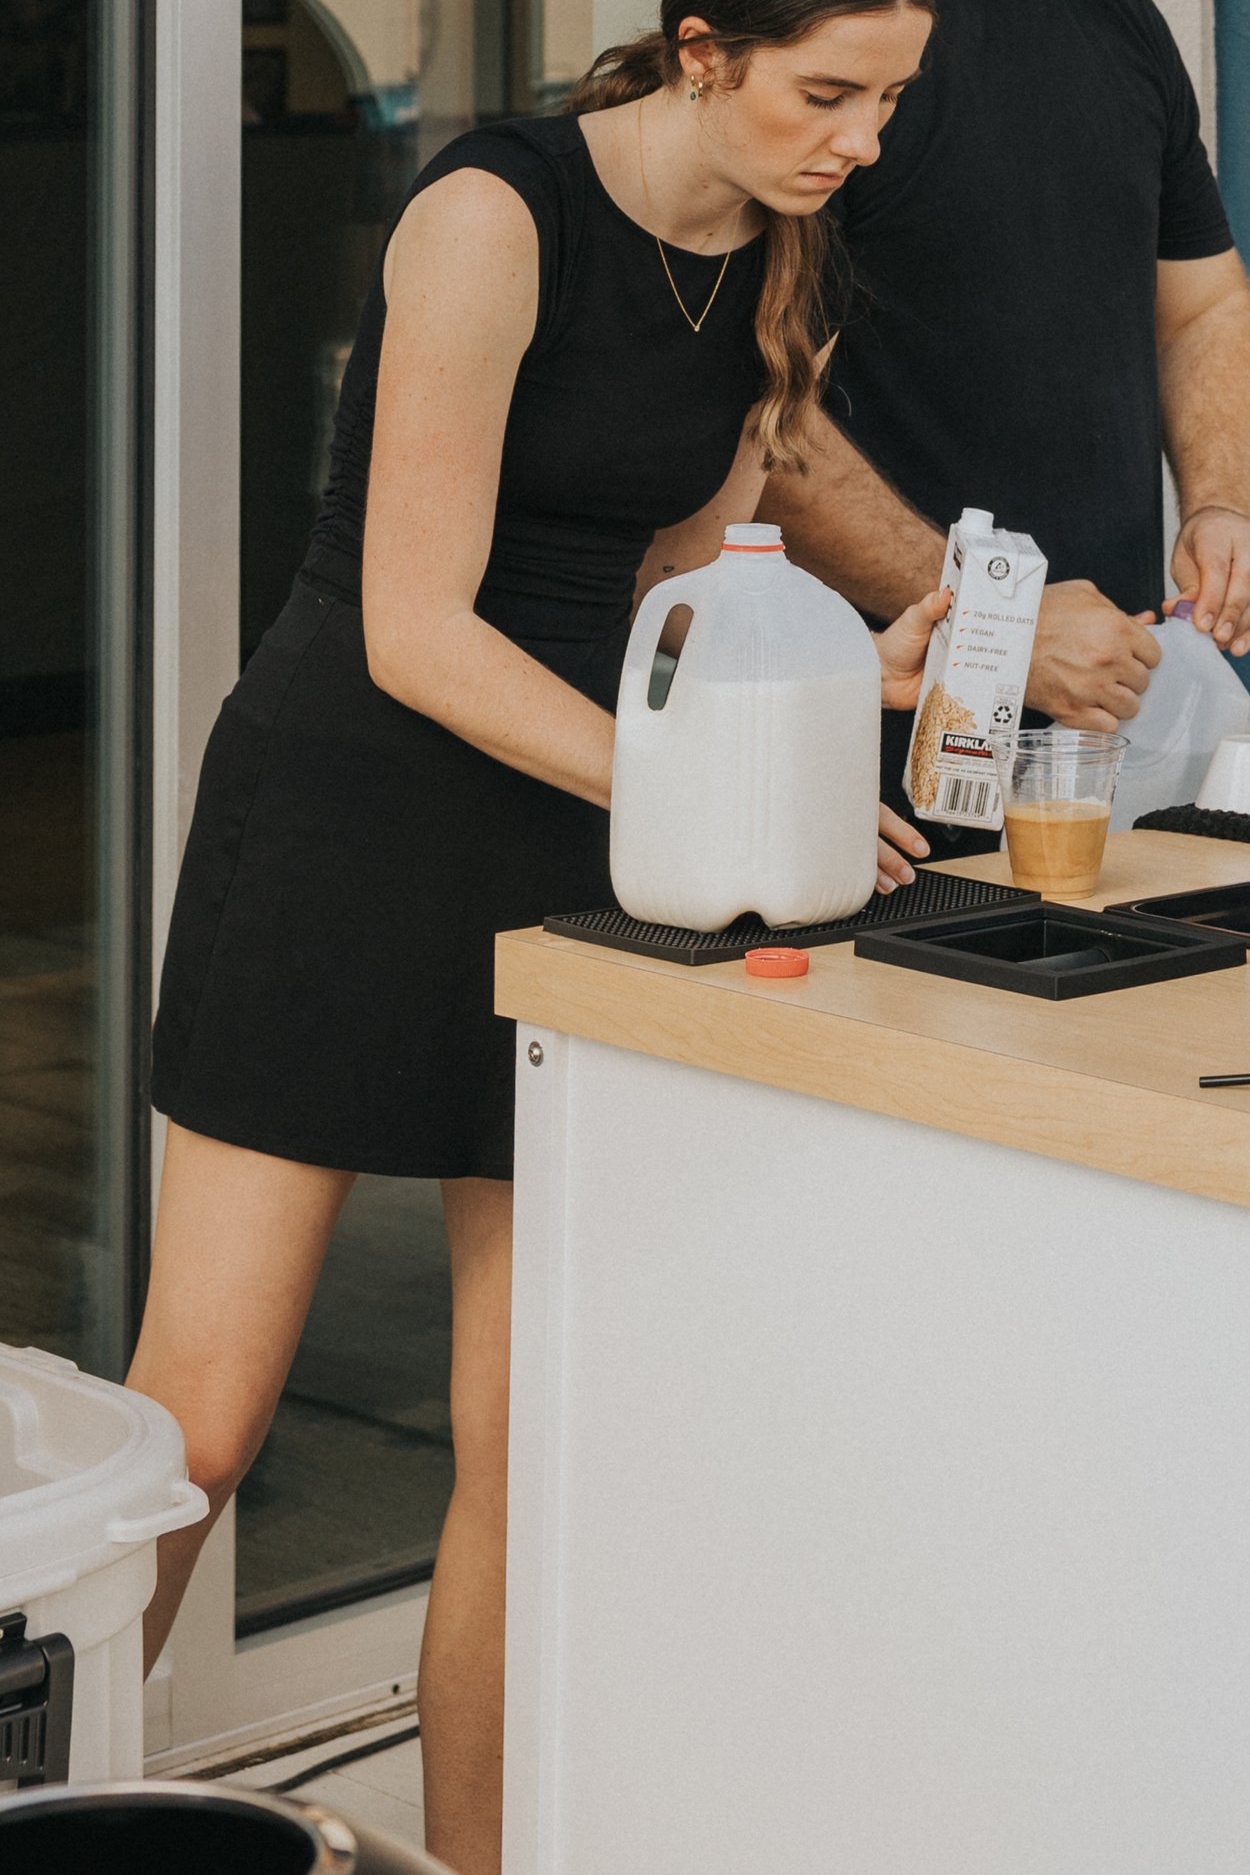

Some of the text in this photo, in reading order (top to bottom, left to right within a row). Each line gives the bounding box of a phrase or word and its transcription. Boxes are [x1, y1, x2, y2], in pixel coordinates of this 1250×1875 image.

[987, 613, 1016, 623] ROLLED
[1016, 617, 1035, 626] OATS
[971, 628, 994, 637] VEGAN
[967, 645, 1007, 656] DAIRY-FREE
[945, 735, 993, 752] KIRKLA
